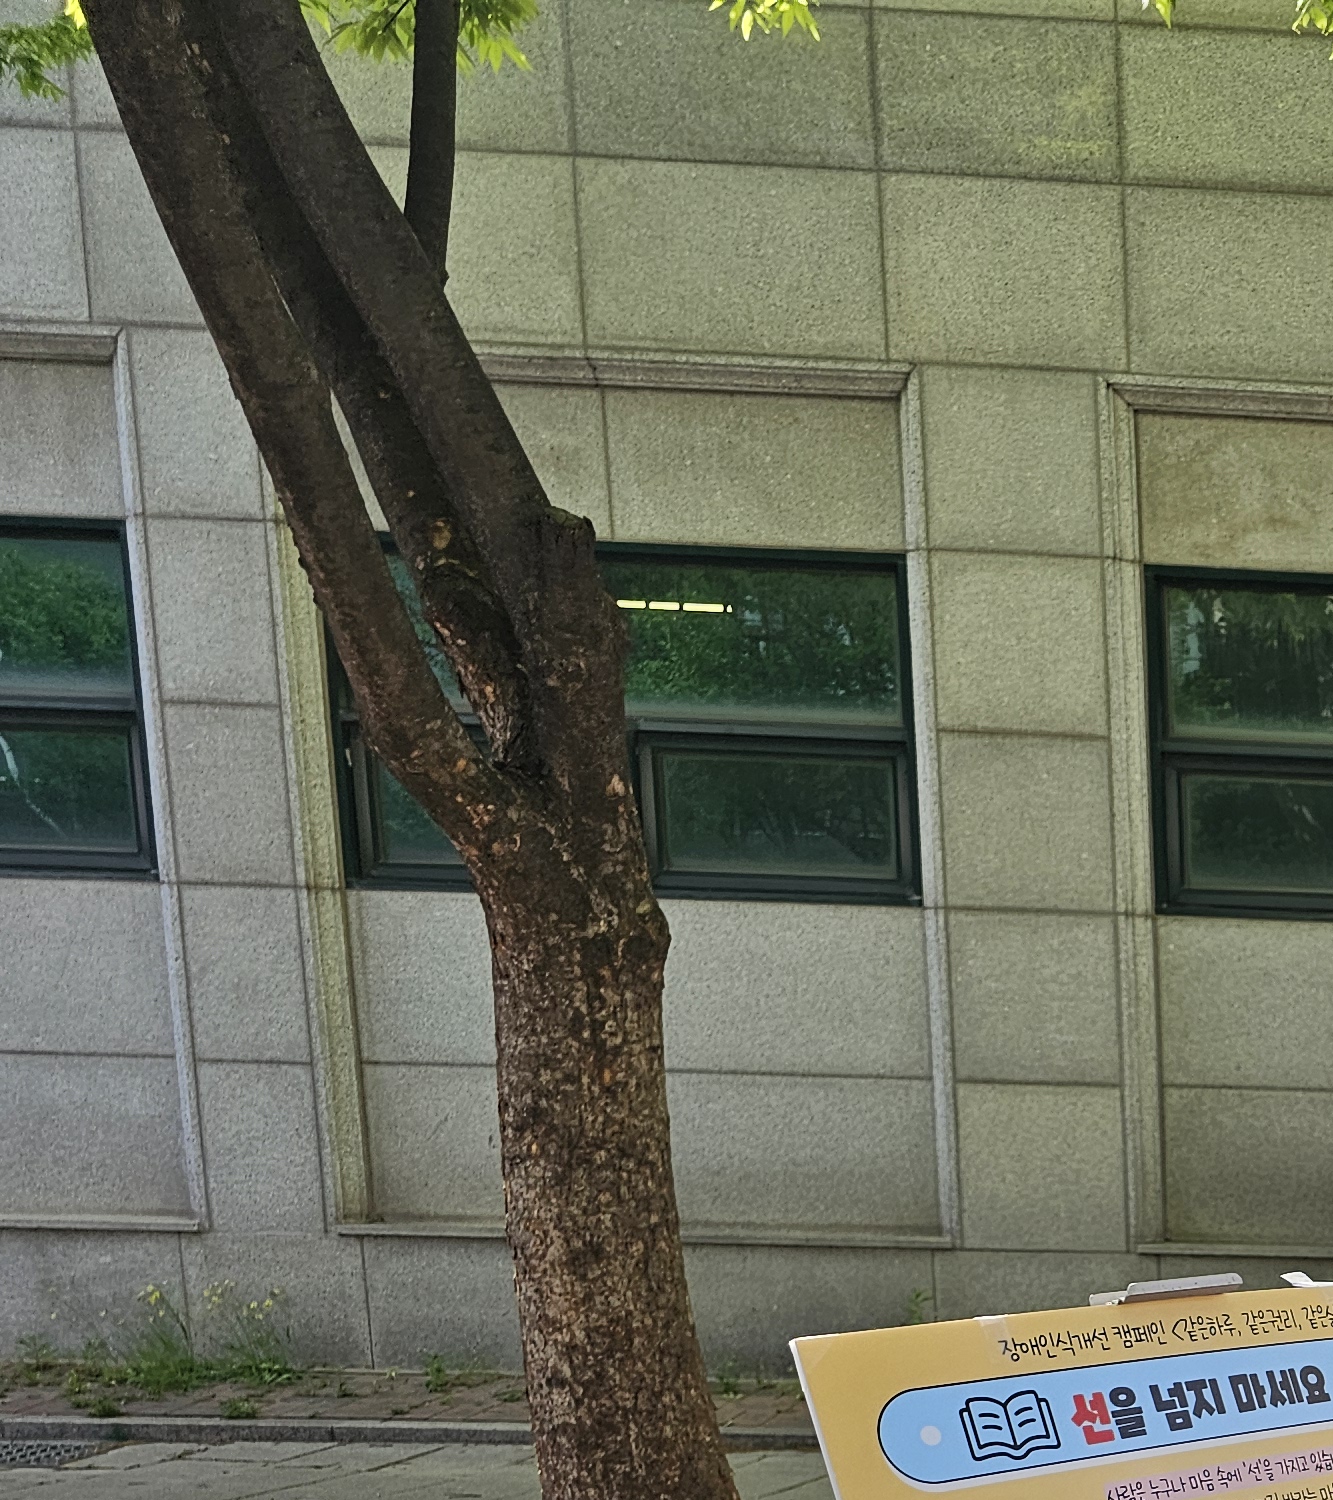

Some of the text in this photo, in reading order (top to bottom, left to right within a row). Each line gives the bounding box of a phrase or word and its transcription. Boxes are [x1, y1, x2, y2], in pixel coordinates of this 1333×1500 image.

[996, 1325, 1112, 1363] 장애인식개선
[1111, 1318, 1168, 1349] 캠페인
[1170, 1312, 1243, 1343] <같은하루,
[1240, 1307, 1303, 1336] 같은권리,
[1070, 1364, 1332, 1446] 선을 넘지 마세요
[1147, 1475, 1187, 1500] 누구나
[1187, 1468, 1216, 1493] 마음
[1215, 1466, 1243, 1489] 속에
[1273, 1454, 1311, 1476] 가지고
